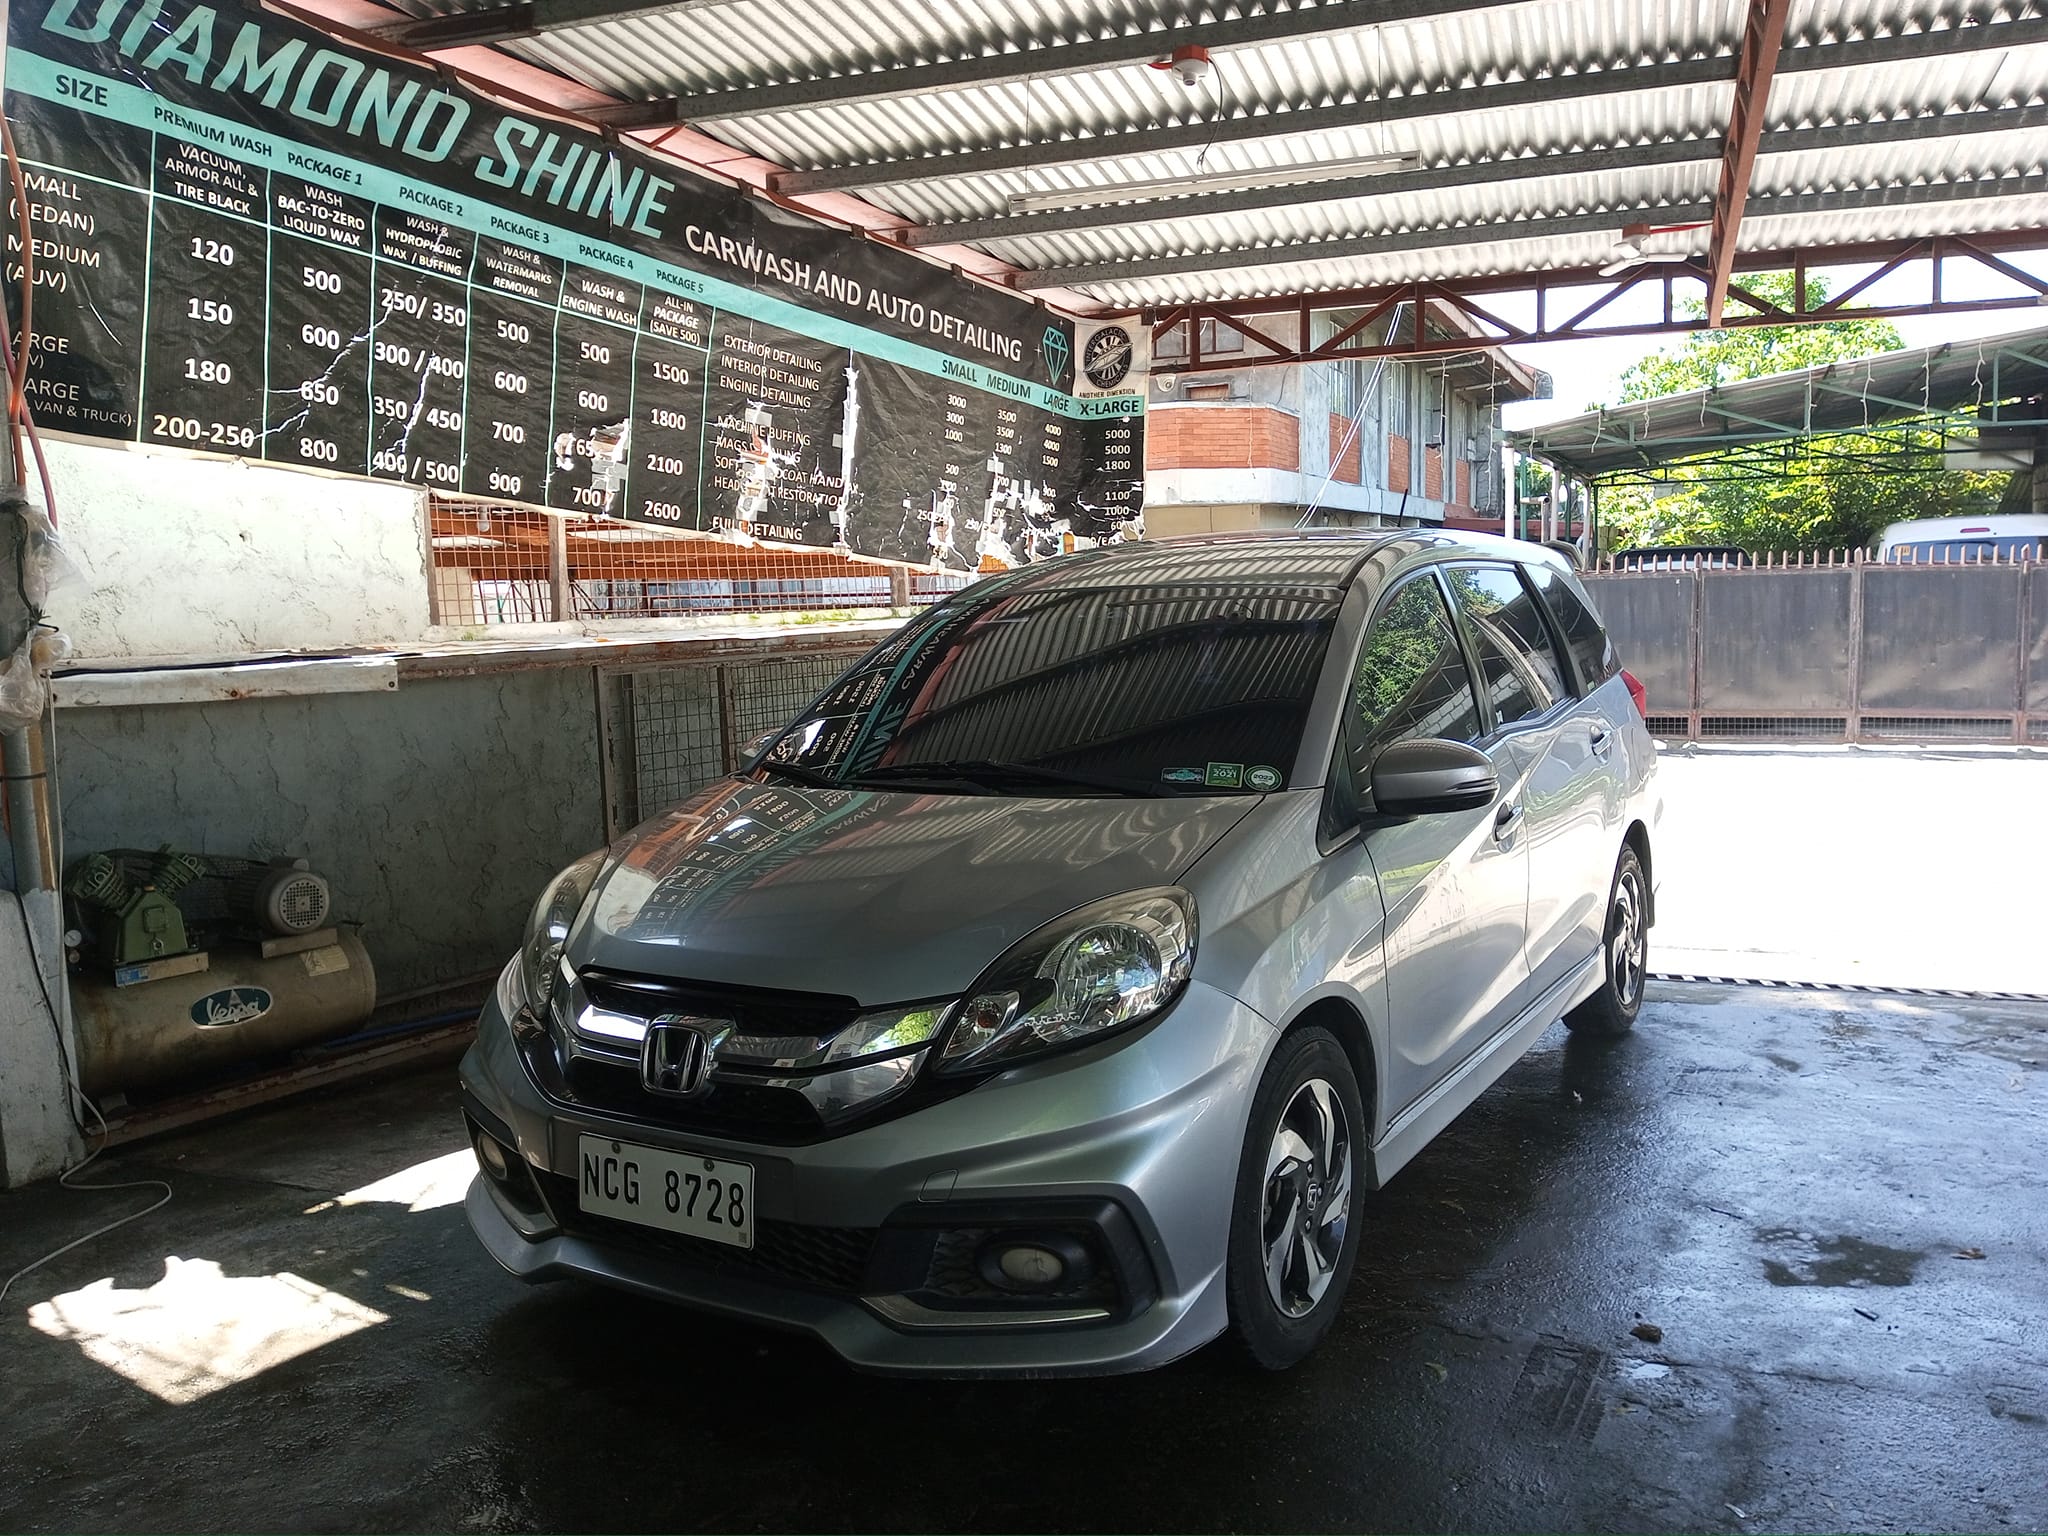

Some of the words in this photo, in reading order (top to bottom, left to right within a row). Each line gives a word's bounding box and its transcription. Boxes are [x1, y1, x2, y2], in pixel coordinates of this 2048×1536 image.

[56, 74, 108, 107] SIZE
[41, 0, 471, 163] DIAMOND
[474, 115, 676, 240] SHINE
[154, 106, 224, 143] PREMIUM
[230, 132, 272, 158] WASH
[179, 144, 247, 180] VACUUM,
[288, 152, 352, 183] PACKAGE
[355, 173, 363, 185] 1
[11, 171, 81, 201] MALL
[165, 158, 220, 186] ARMOR
[222, 173, 245, 193] ALL
[247, 183, 258, 197] &
[175, 182, 205, 201] TIRE
[208, 190, 251, 215] BLACK
[304, 184, 343, 208] WASH
[399, 186, 455, 214] PACKAGE
[456, 204, 463, 217] 2
[9, 198, 95, 236] (EDAN)
[277, 196, 366, 232] BAC-TO-ZERO
[283, 215, 328, 240] LIQUID
[330, 228, 361, 247] WAX
[406, 216, 441, 234] WASH
[441, 225, 449, 238] &
[490, 216, 540, 242] PACKAGE
[542, 231, 550, 244] 3
[8, 234, 100, 268] MEDIUM
[191, 237, 234, 266] 120
[385, 228, 462, 260] HYDROPHOBIC
[503, 246, 532, 262] WASH
[533, 253, 541, 264] &
[382, 244, 408, 261] WAX
[419, 254, 462, 277] BUFFING
[579, 244, 623, 268] PACKAGE
[624, 257, 634, 270] 4
[303, 266, 341, 294] 500
[486, 257, 552, 285] WATERMARKS
[656, 269, 697, 291] PACKAGE
[698, 283, 704, 294] 5
[493, 277, 539, 298] REMOVAL
[582, 280, 612, 300] WASH
[615, 290, 625, 304] &
[685, 224, 810, 291] CARWASH
[814, 270, 862, 306] AND
[866, 288, 925, 328] AUTO
[929, 310, 1023, 362] DETAILING
[187, 298, 233, 325] 150
[432, 301, 466, 327] 350
[562, 295, 602, 318] ENGINE
[603, 308, 637, 327] WASH
[664, 296, 694, 313] ALL-IN
[653, 307, 699, 330] PACKAGE
[12, 331, 70, 354] ARGE
[302, 324, 339, 350] 600
[497, 320, 529, 344] 500
[650, 319, 678, 339] (SAVE
[679, 327, 701, 346] 500)
[374, 341, 410, 367] 300
[430, 356, 464, 379] 400
[580, 342, 610, 365] 500
[724, 335, 770, 359] EXTERIOR
[772, 346, 822, 373] DETAILING
[184, 358, 231, 385] 180
[494, 371, 527, 394] 600
[653, 362, 689, 386] 1500
[721, 354, 767, 379] INTERIOR
[769, 368, 820, 392] DETAILING
[942, 359, 977, 383] SMALL
[300, 380, 339, 406] 650
[720, 375, 758, 397] ENGINE
[761, 386, 811, 408] DETAILING
[986, 374, 1031, 399] MEDIUM
[1079, 391, 1105, 399] ANOTHER
[1106, 388, 1136, 397] DIMENSION
[578, 390, 607, 412] 600
[947, 394, 966, 409] 3000
[1043, 391, 1069, 412] LARGE
[1080, 400, 1139, 416] X-LARGE
[34, 400, 62, 415] VAN
[67, 405, 78, 418] &
[82, 408, 131, 428] TRUCK)
[374, 396, 407, 419] 350
[426, 408, 461, 431] 450
[650, 408, 686, 431] 1800
[946, 411, 965, 426] 3000
[997, 409, 1016, 423] 3500
[153, 414, 254, 449] 200-250
[492, 421, 524, 444] 700
[717, 415, 766, 438] MACHINE
[769, 426, 811, 446] BUFFING
[944, 429, 963, 443] 1000
[996, 426, 1014, 439] 3500
[1044, 424, 1061, 437] 4000
[1105, 430, 1130, 439] 5000
[299, 437, 338, 462] 800
[717, 436, 748, 452] MAGS
[995, 442, 1012, 455] 1300
[1043, 440, 1059, 453] 4000
[1105, 445, 1130, 455] 5000
[372, 450, 407, 472] 400
[425, 461, 459, 484] 500
[647, 454, 683, 476] 2100
[945, 464, 959, 476] 500
[1042, 454, 1058, 467] 1500
[1105, 460, 1130, 470] 1800
[488, 472, 521, 495] 900
[809, 473, 843, 488] HAND
[572, 486, 602, 507] 700
[1105, 491, 1130, 501] 1100
[643, 500, 681, 521] 2600
[1105, 507, 1129, 516] 1000
[748, 523, 803, 541] DETAILING
[584, 1153, 640, 1205] NCG
[664, 1170, 745, 1228] 8728
